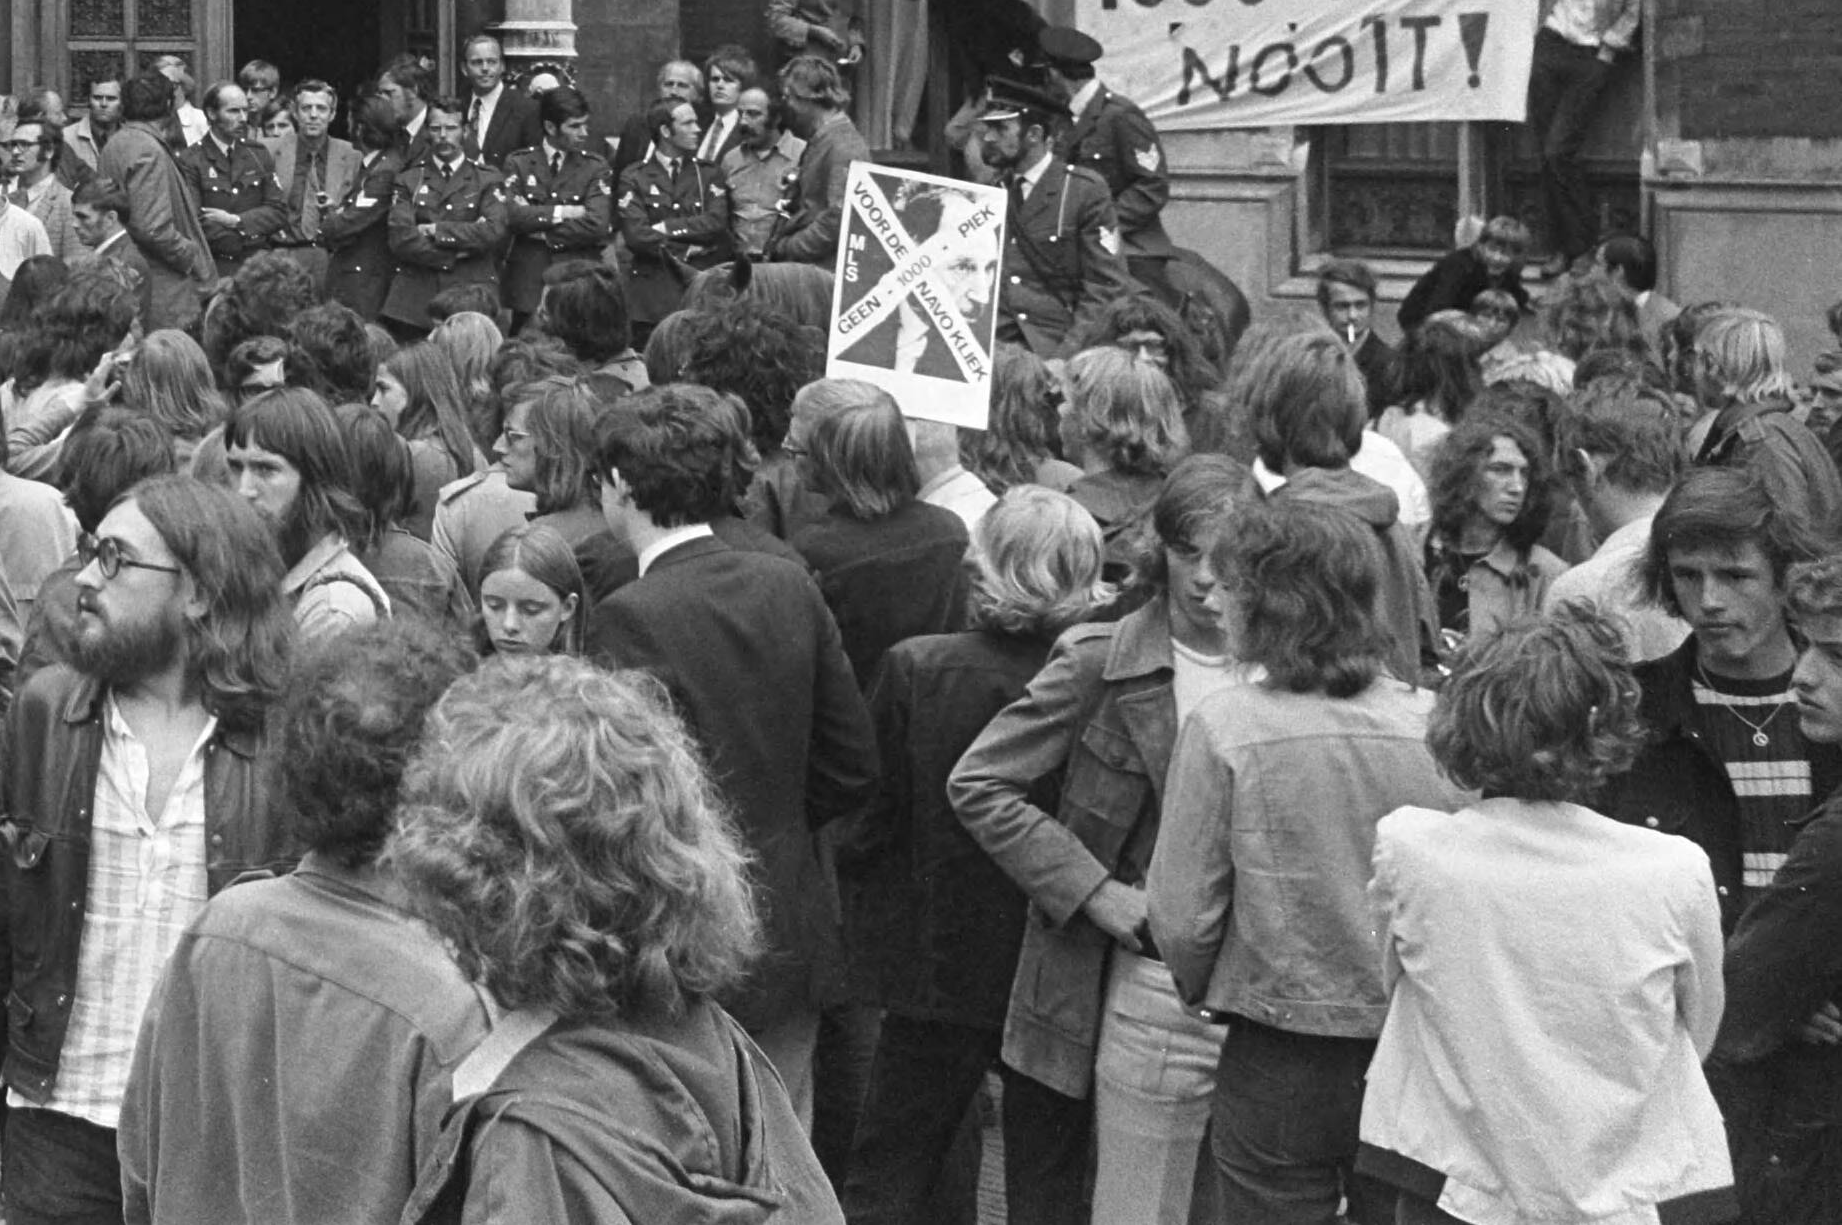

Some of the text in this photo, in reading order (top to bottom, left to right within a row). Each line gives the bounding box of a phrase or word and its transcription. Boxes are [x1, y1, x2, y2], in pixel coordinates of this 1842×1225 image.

[1170, 12, 1490, 105] NOOIT!
[837, 295, 882, 335] GEEN
[896, 254, 932, 287] 1000
[958, 205, 996, 238] PIEK
[846, 233, 866, 283] MLS
[853, 181, 989, 382] VOOR DE NAVO KLIEK
